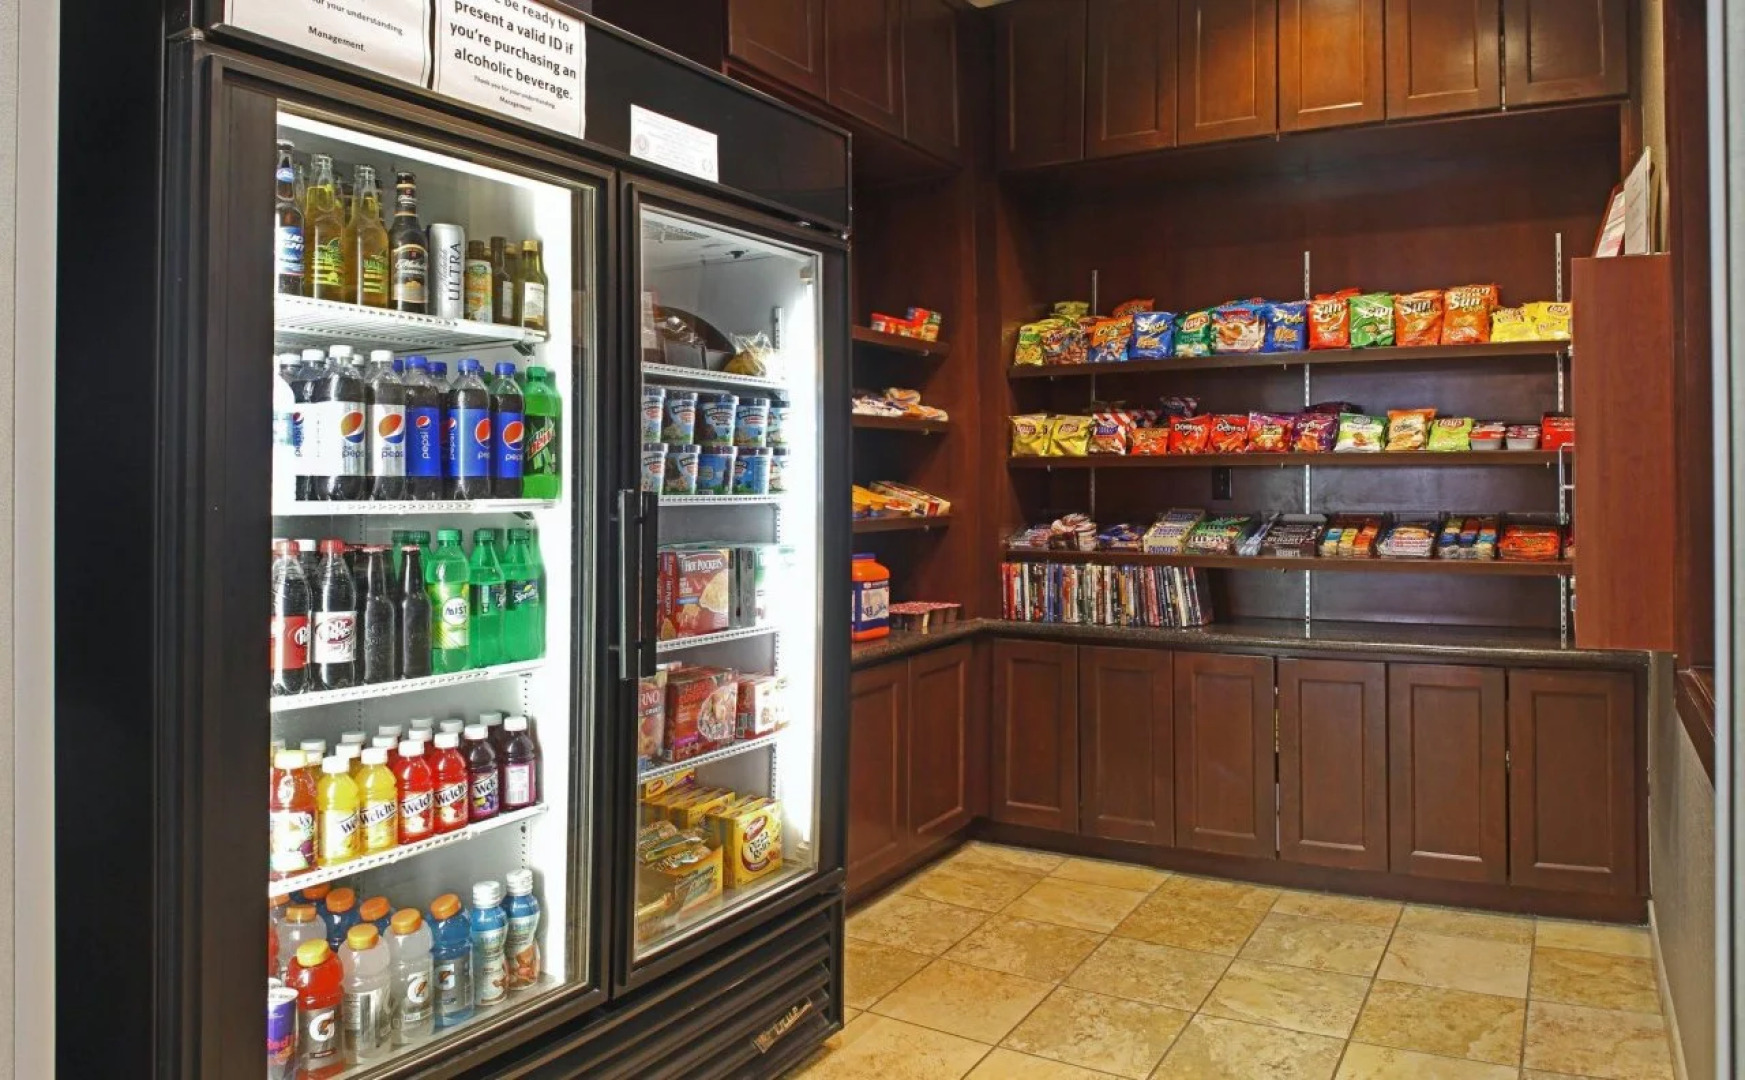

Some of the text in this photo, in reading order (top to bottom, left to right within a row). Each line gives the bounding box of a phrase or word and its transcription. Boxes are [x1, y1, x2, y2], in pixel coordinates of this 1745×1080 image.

[326, 2, 345, 12] your
[522, 5, 555, 29] ready
[558, 18, 570, 32] to
[307, 25, 367, 52] Management.
[454, 0, 574, 56] present a valid ID if
[450, 22, 577, 79] you're purchasing an
[454, 47, 574, 100] alcoholic beverage.
[448, 243, 462, 301] ULTRA
[1403, 300, 1432, 316] Sun
[1449, 291, 1480, 310] Sun
[420, 430, 430, 460] pepsi
[309, 1009, 335, 1042] G
